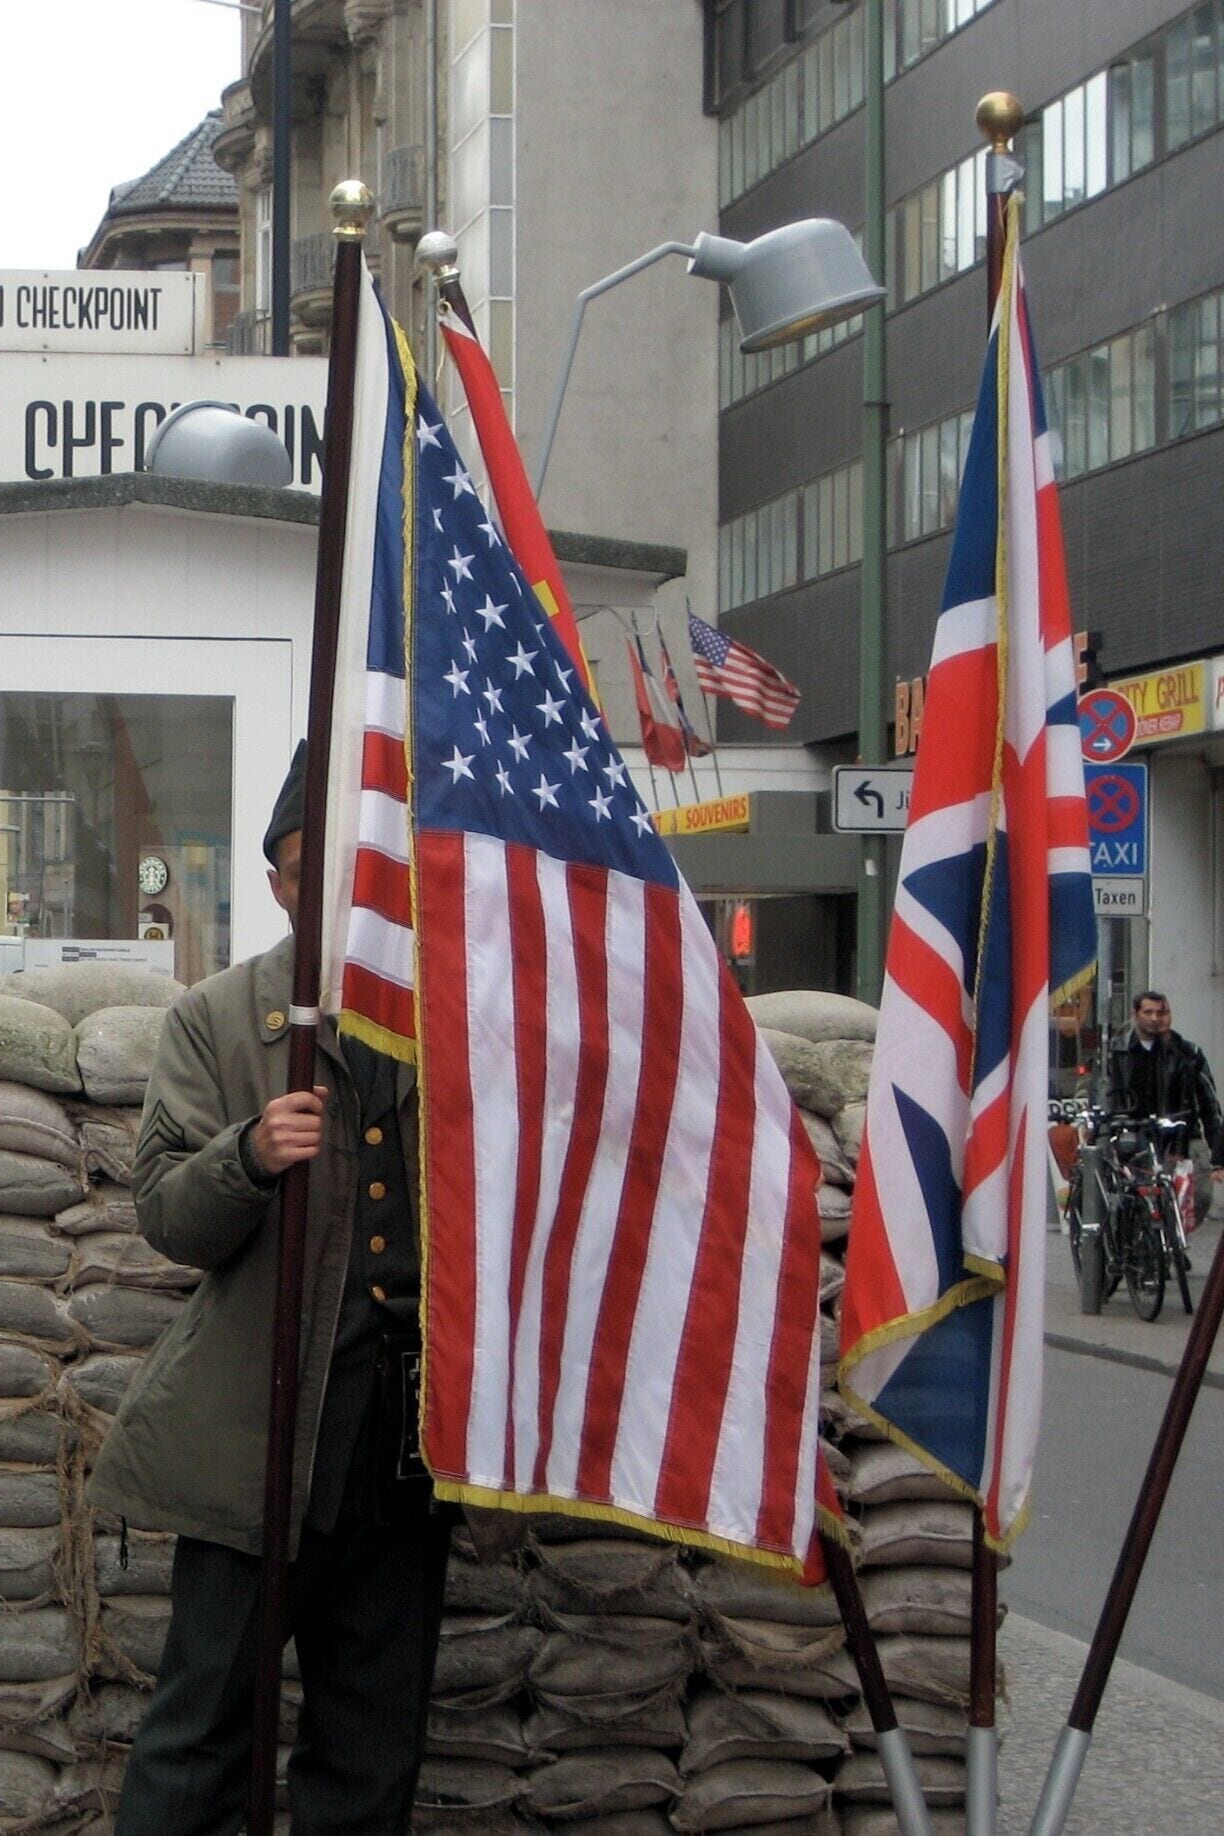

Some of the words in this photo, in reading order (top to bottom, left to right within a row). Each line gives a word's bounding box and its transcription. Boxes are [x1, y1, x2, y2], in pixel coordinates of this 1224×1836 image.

[16, 285, 163, 332] CHECKPOINT
[1157, 670, 1199, 710] GRILL
[685, 797, 747, 829] SOUVENIRS
[1095, 888, 1137, 906] Taxen
